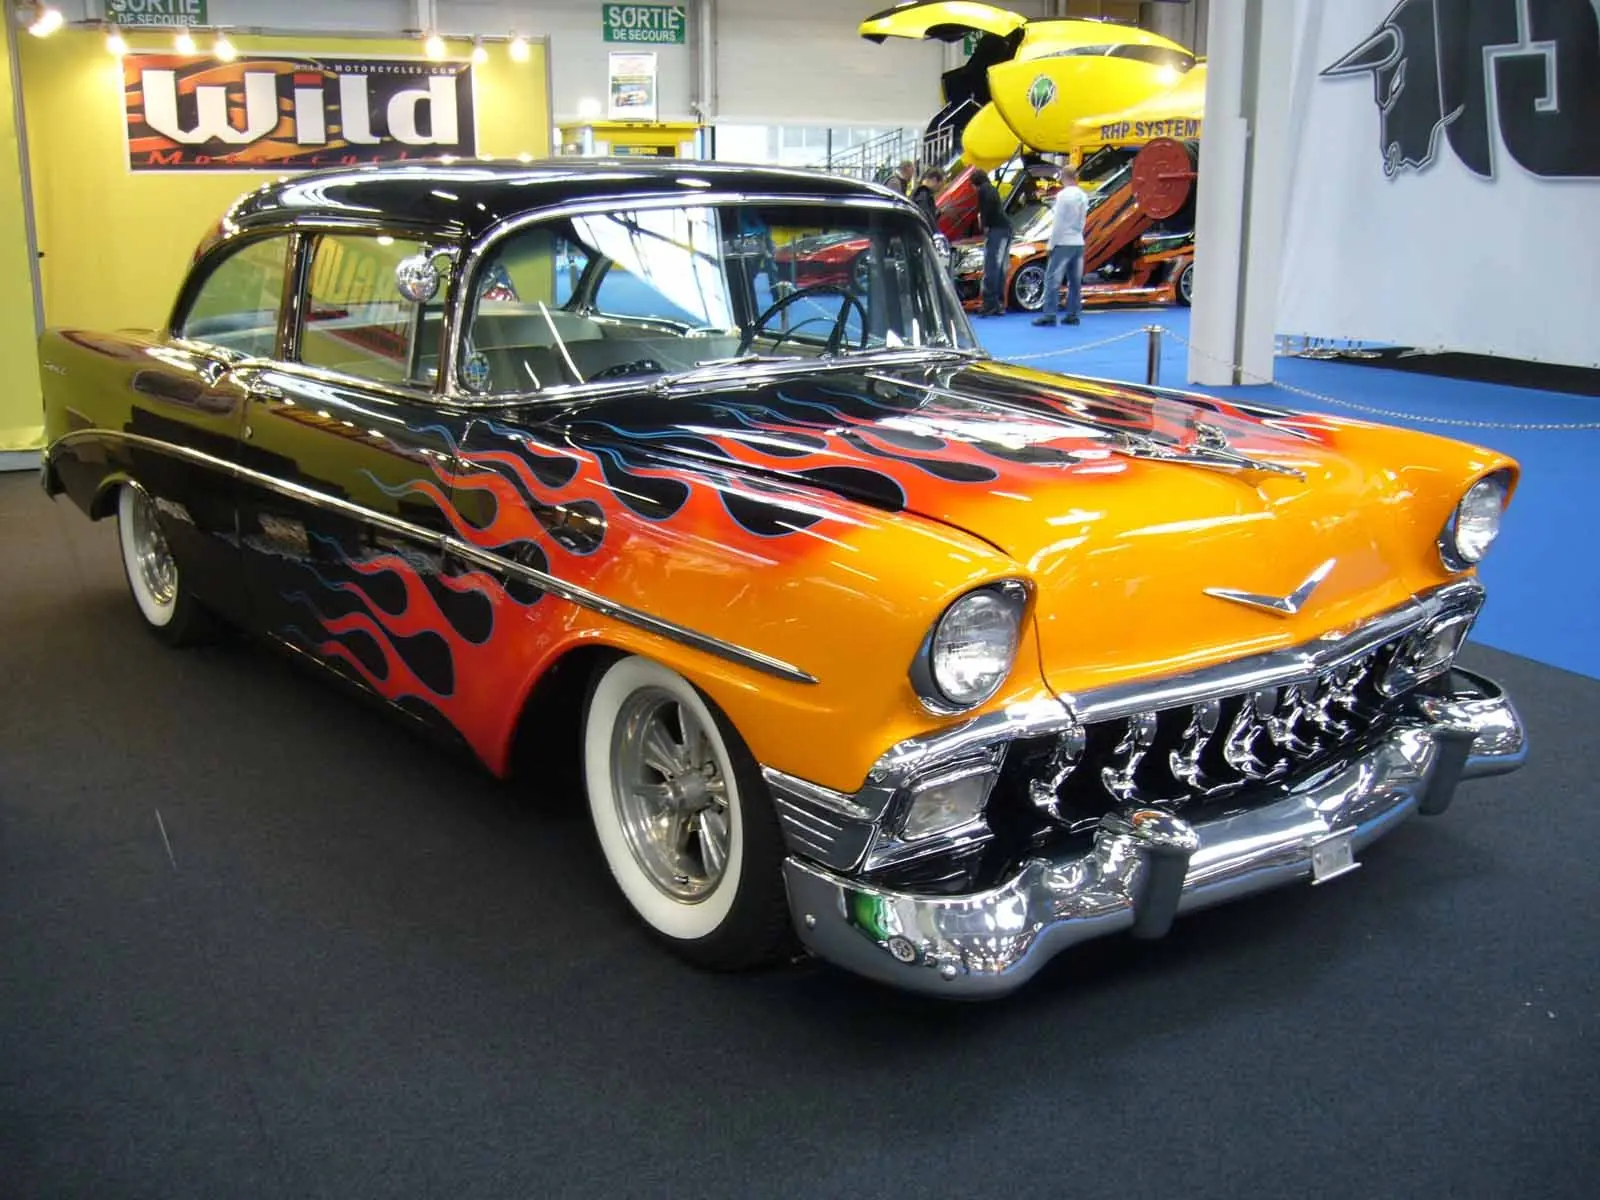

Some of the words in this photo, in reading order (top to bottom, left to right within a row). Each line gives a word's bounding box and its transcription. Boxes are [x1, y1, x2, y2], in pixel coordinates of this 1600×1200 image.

[117, 13, 135, 25] DE
[137, 14, 197, 25] SECOURS
[608, 6, 680, 29] SORTIE
[612, 28, 627, 40] DE
[628, 29, 677, 41] SECOURS
[141, 69, 458, 145] Wild
[1101, 121, 1130, 140] RHP
